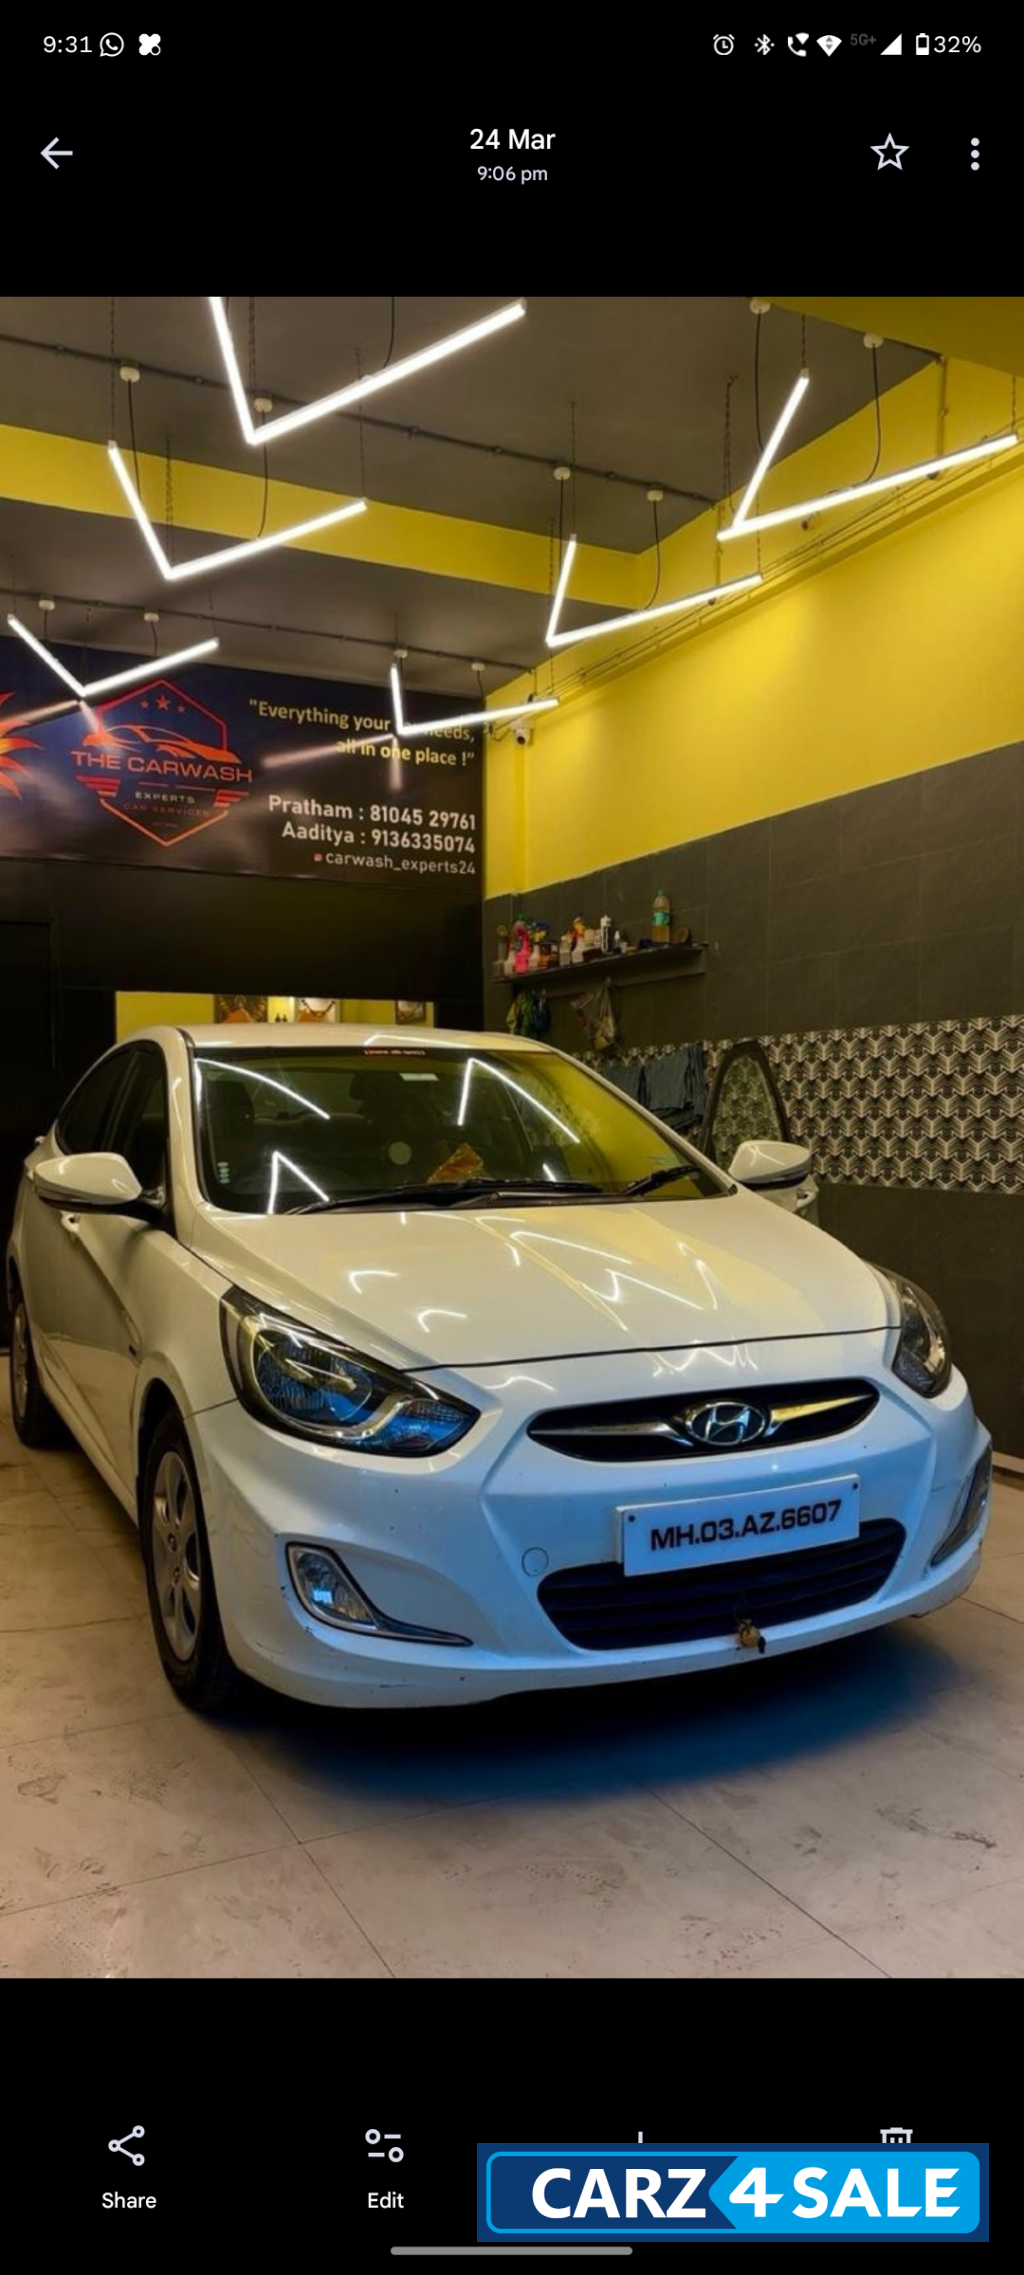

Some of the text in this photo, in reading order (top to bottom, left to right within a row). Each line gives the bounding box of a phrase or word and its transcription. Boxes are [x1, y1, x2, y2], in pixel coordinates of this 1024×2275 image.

[43, 36, 92, 53] 9:31
[850, 33, 876, 46] 5G+
[933, 35, 981, 53] 32%
[469, 128, 556, 150] 24 Mar
[477, 166, 548, 185] 9:06 pm
[249, 699, 349, 730] "Everything
[353, 716, 391, 732] your
[335, 738, 354, 755] all
[360, 741, 376, 756] in
[380, 749, 411, 760] one
[415, 746, 456, 765] place
[71, 750, 252, 783] THE CARWASH
[135, 791, 196, 804] EXPERTS
[268, 795, 476, 831] Pratham : 81045 29761
[282, 821, 476, 854] Aaditya : 9136335074
[325, 852, 476, 875] carwash_experts24
[650, 1499, 842, 1551] MH.03.AZ.6607
[101, 2191, 157, 2210] Share
[367, 2190, 405, 2210] Edit
